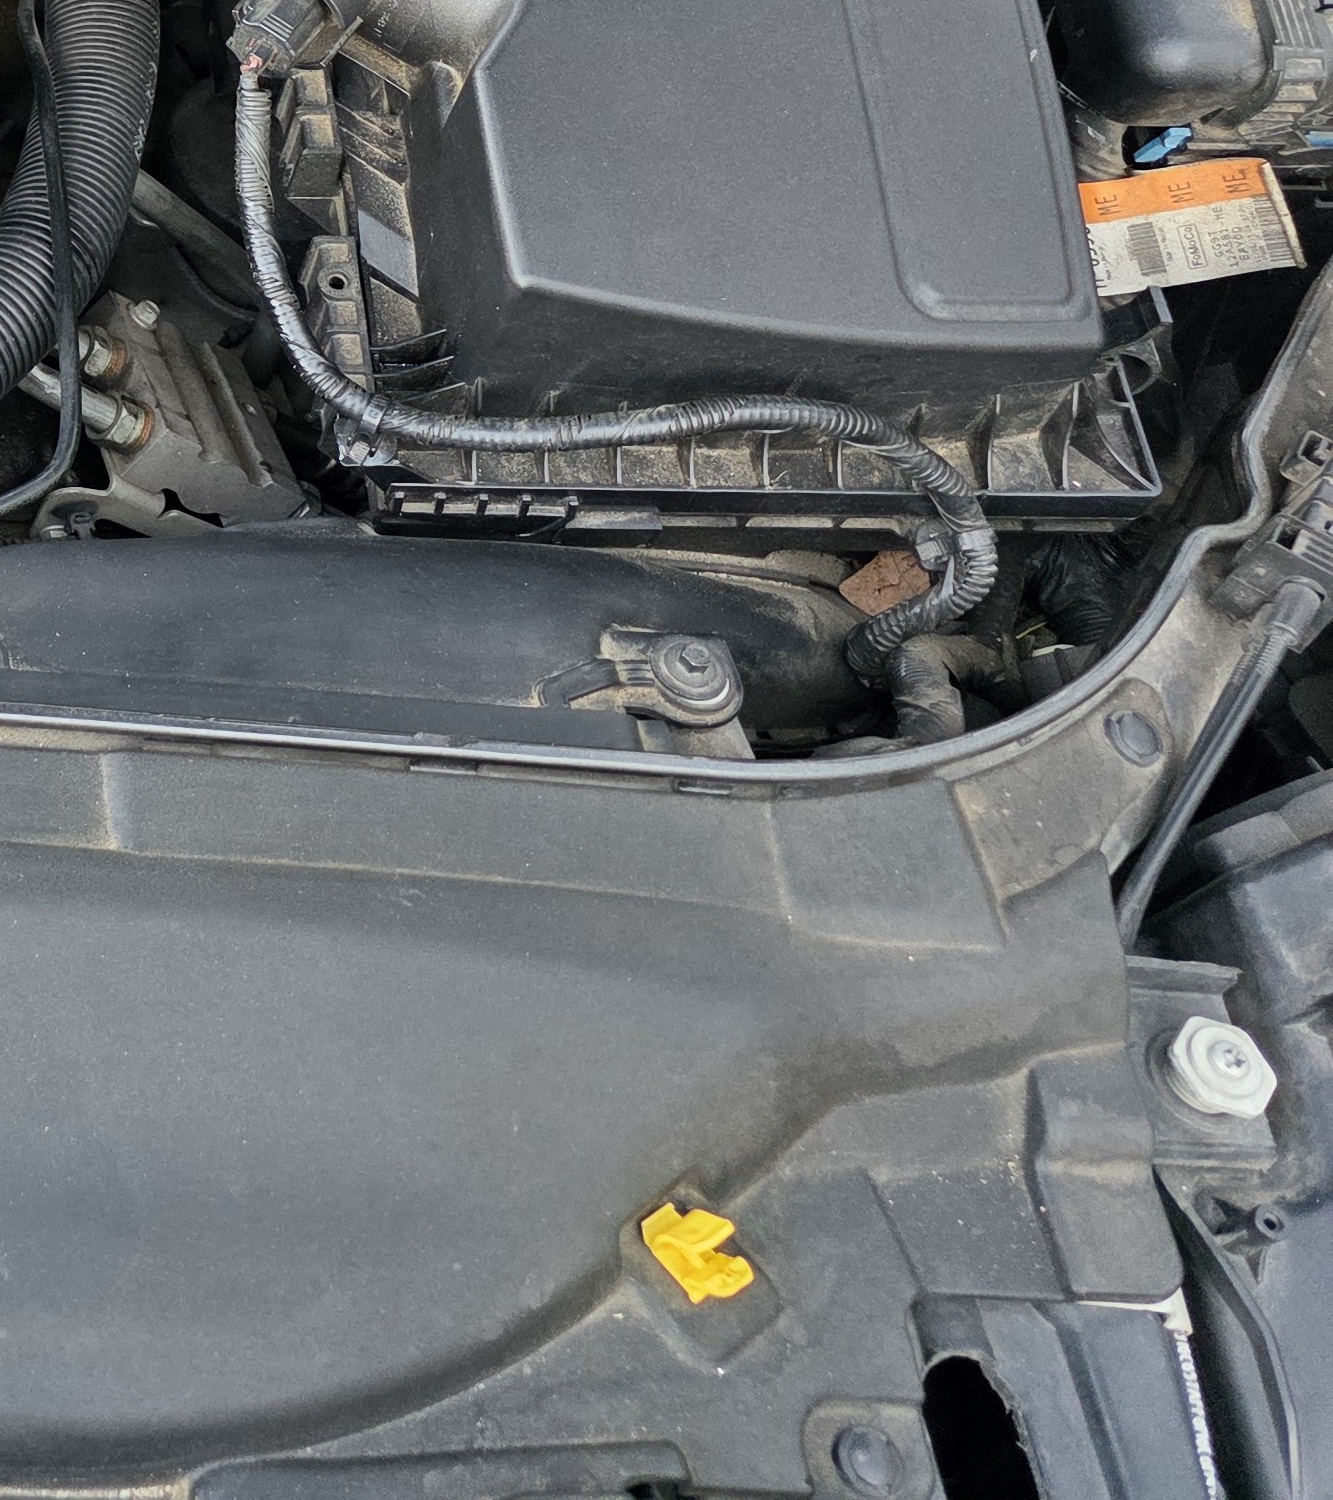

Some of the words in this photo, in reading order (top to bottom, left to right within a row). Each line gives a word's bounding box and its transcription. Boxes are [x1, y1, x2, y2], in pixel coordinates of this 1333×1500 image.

[1168, 181, 1195, 204] ME
[1222, 173, 1251, 194] ME
[1095, 194, 1121, 217] ME
[1184, 225, 1206, 267] FoMoCo
